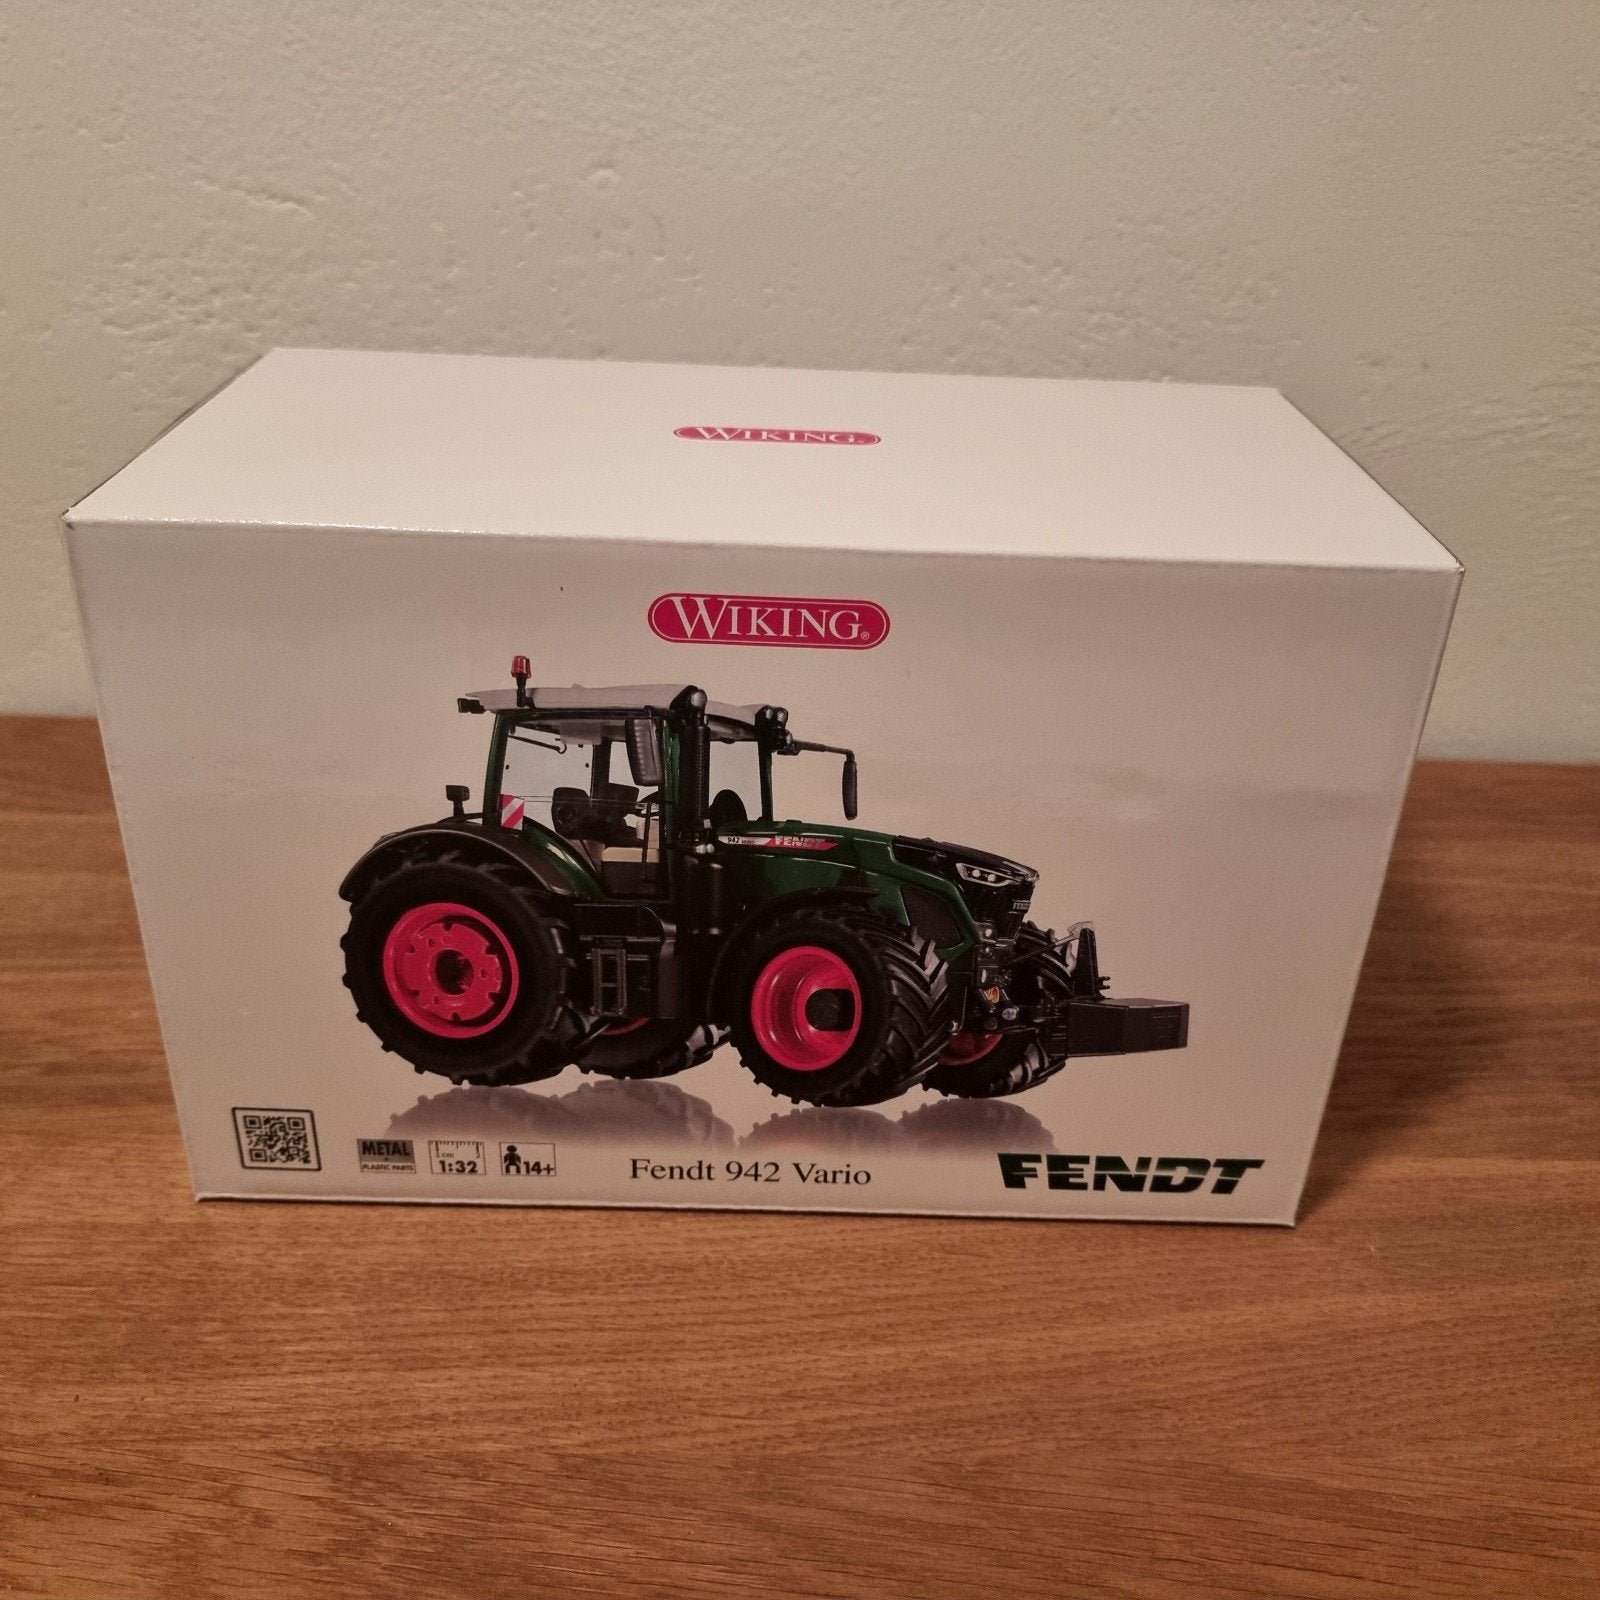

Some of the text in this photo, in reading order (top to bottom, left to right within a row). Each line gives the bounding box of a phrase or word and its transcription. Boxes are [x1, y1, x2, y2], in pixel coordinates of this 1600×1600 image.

[695, 427, 856, 444] WIKING
[670, 596, 863, 640] WIKING
[727, 836, 740, 844] 942
[361, 1140, 411, 1157] METAL
[439, 1159, 479, 1174] 1:32
[523, 1160, 555, 1175] 14+
[629, 1158, 872, 1185] Fendt 942 Vario
[997, 1152, 1266, 1195] FENDT
